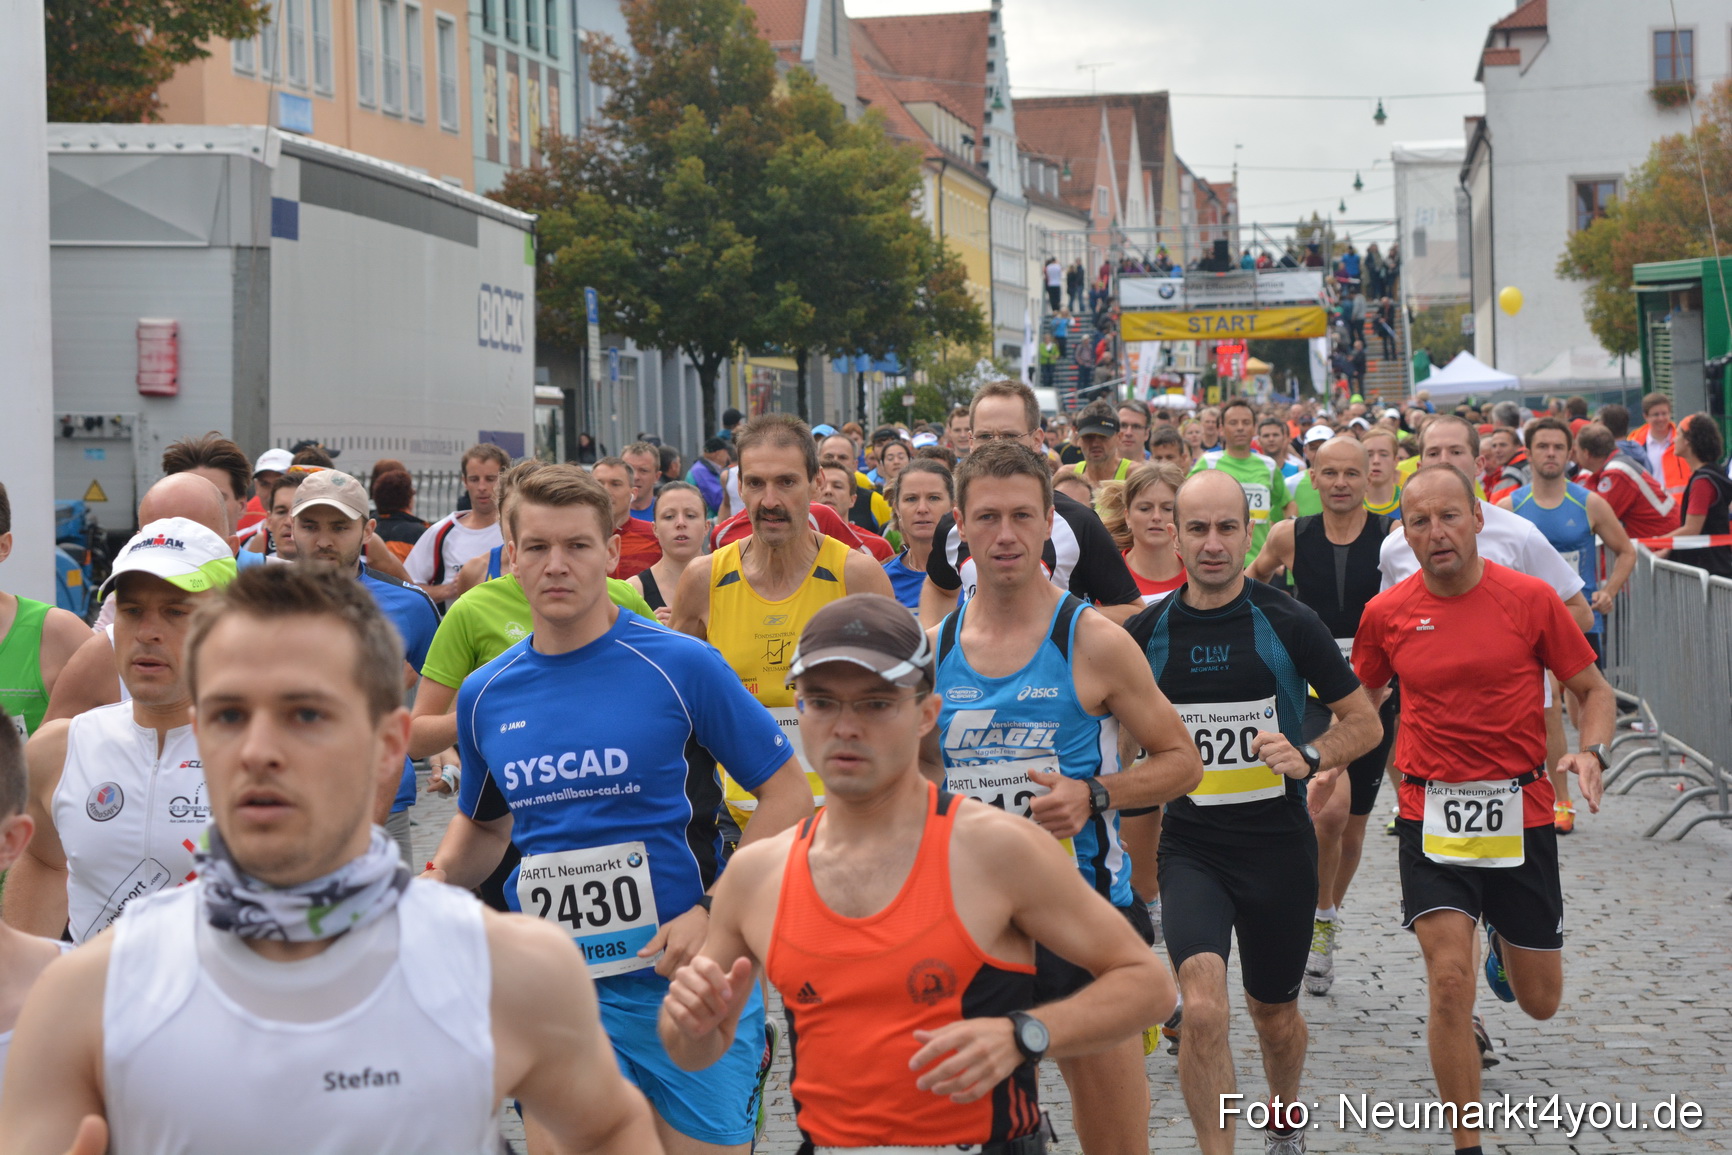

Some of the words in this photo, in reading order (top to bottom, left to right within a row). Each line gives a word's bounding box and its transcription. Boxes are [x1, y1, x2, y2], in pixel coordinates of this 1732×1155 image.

[478, 282, 525, 352] BOCK
[1188, 315, 1258, 333] START
[1031, 687, 1058, 699] asics
[507, 720, 527, 731] JAKO
[990, 721, 1060, 732] Versicherungsbüro
[1208, 711, 1260, 723] Neumarkt
[961, 728, 1057, 749] NAGEL
[504, 747, 629, 791] SYSCAD
[949, 778, 977, 790] PARTL
[979, 773, 1032, 788] Neumark
[1426, 787, 1456, 796] PARTL
[1458, 787, 1507, 797] Neumarkt
[508, 782, 642, 810] www.metallbau-cad.de
[1443, 798, 1504, 834] 626
[519, 866, 557, 881] PARTL
[557, 858, 623, 877] Neumarkt
[530, 875, 642, 930] 2430
[323, 1065, 401, 1092] Stefan
